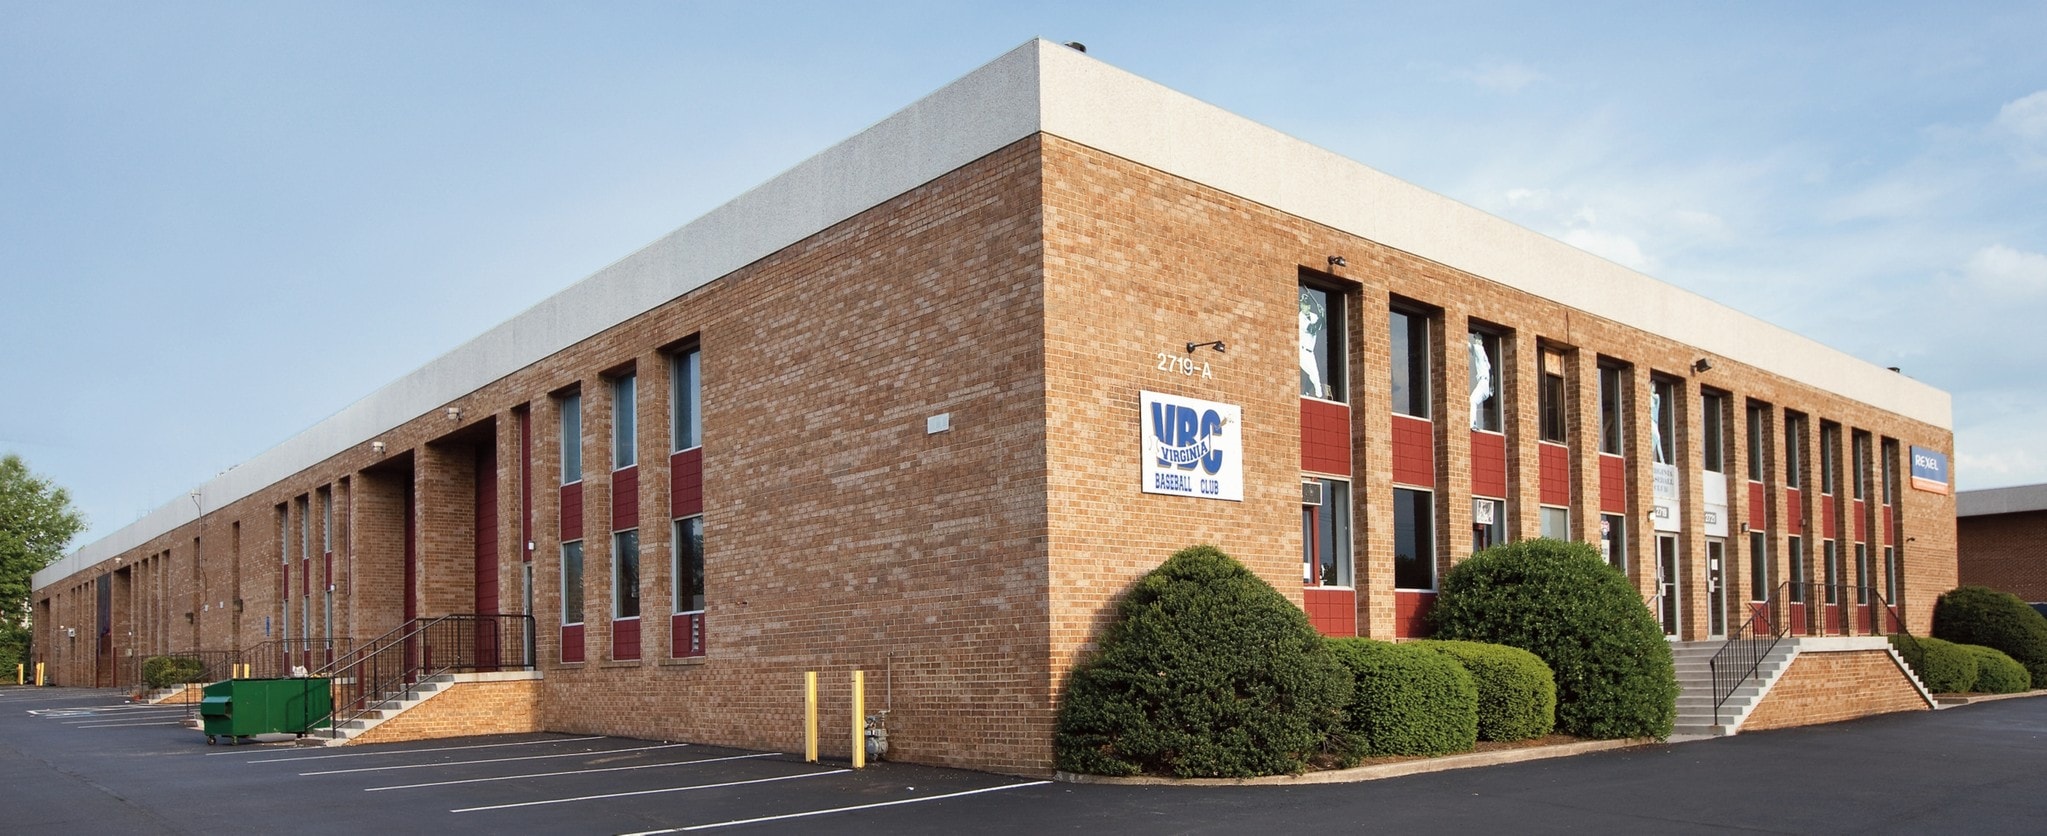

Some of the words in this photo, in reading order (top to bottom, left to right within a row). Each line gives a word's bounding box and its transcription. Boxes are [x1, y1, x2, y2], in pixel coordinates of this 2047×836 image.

[1157, 353, 1212, 379] 2719-A
[1151, 401, 1223, 475] VBC
[1161, 441, 1208, 463] VIRGINIA
[1915, 454, 1939, 471] REXEL
[1155, 473, 1192, 492] BASEBALL
[1200, 479, 1219, 495] CLUB
